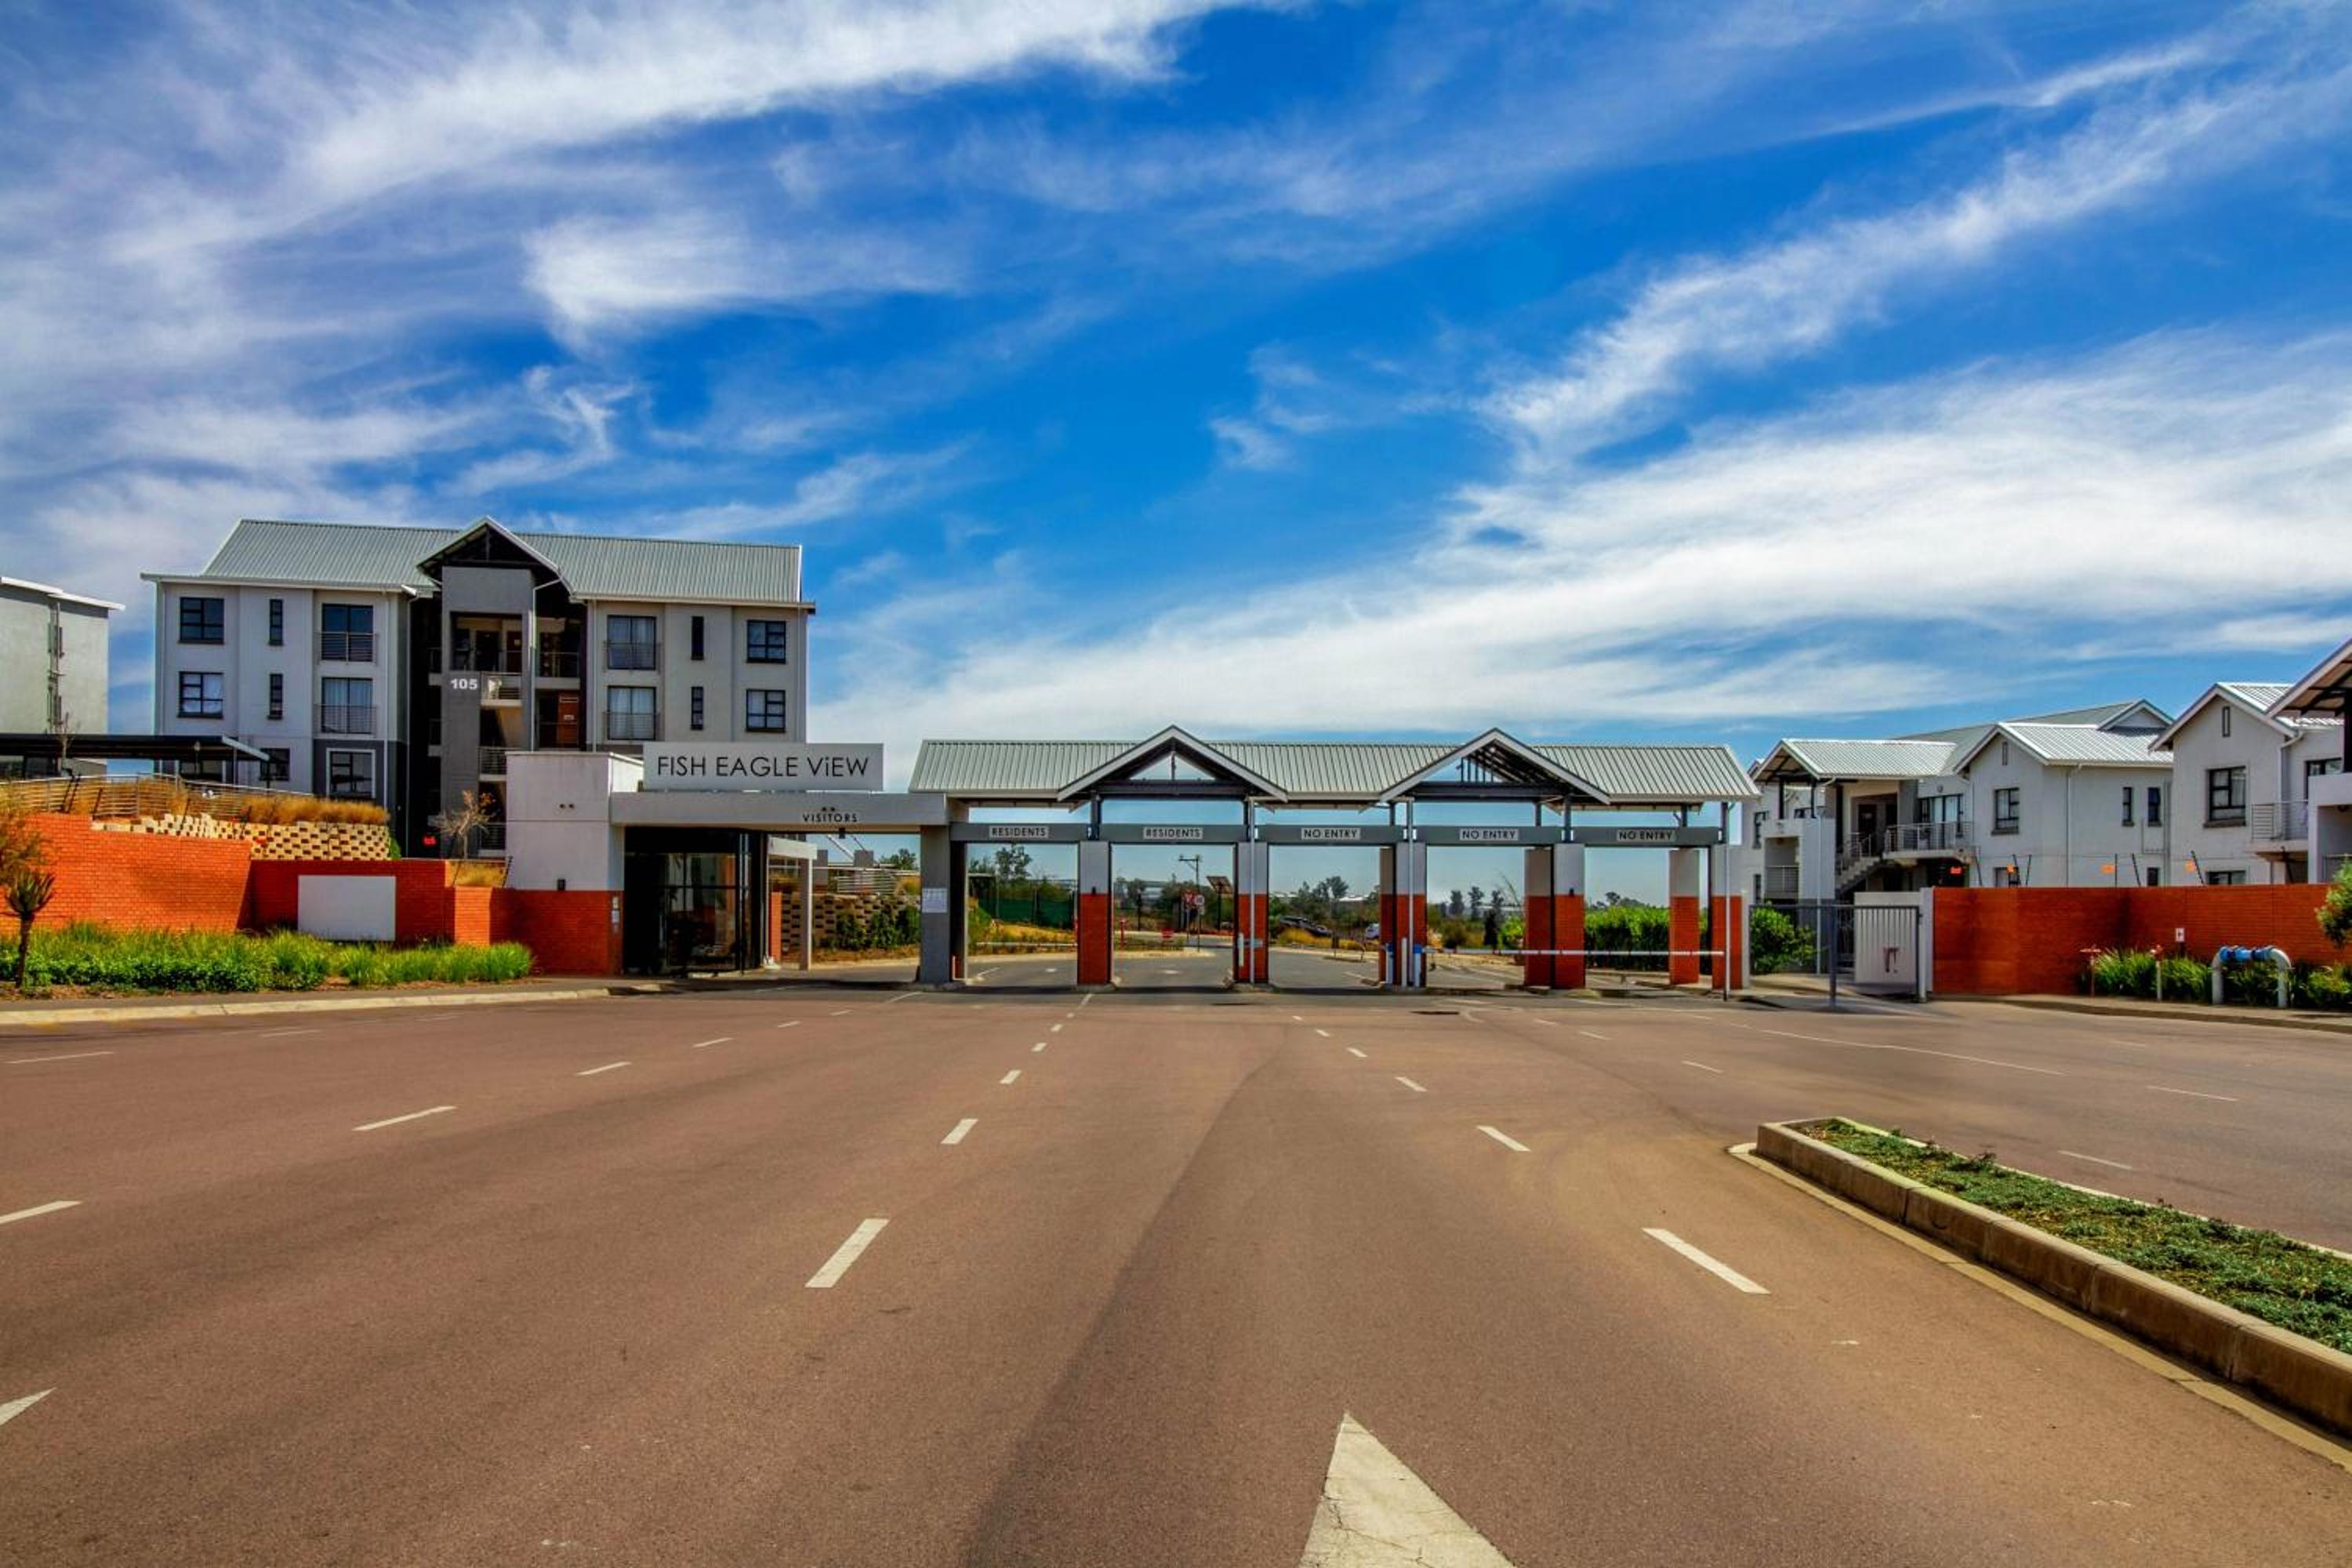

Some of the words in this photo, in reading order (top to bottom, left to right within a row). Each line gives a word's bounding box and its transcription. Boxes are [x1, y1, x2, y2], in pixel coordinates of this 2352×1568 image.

[451, 678, 477, 689] 105
[658, 756, 706, 776] FISH
[716, 756, 798, 777] EAGLE
[802, 813, 858, 822] VISITORS
[991, 827, 1047, 837] RESIDENTS
[1145, 829, 1201, 838] RESIDENTS
[1304, 829, 1321, 838] NO
[1324, 829, 1357, 838] ENTRY
[1462, 830, 1479, 839] NO
[1483, 830, 1515, 839] ENTRY
[1619, 831, 1636, 840] NO
[1639, 831, 1672, 840] ENTRY
